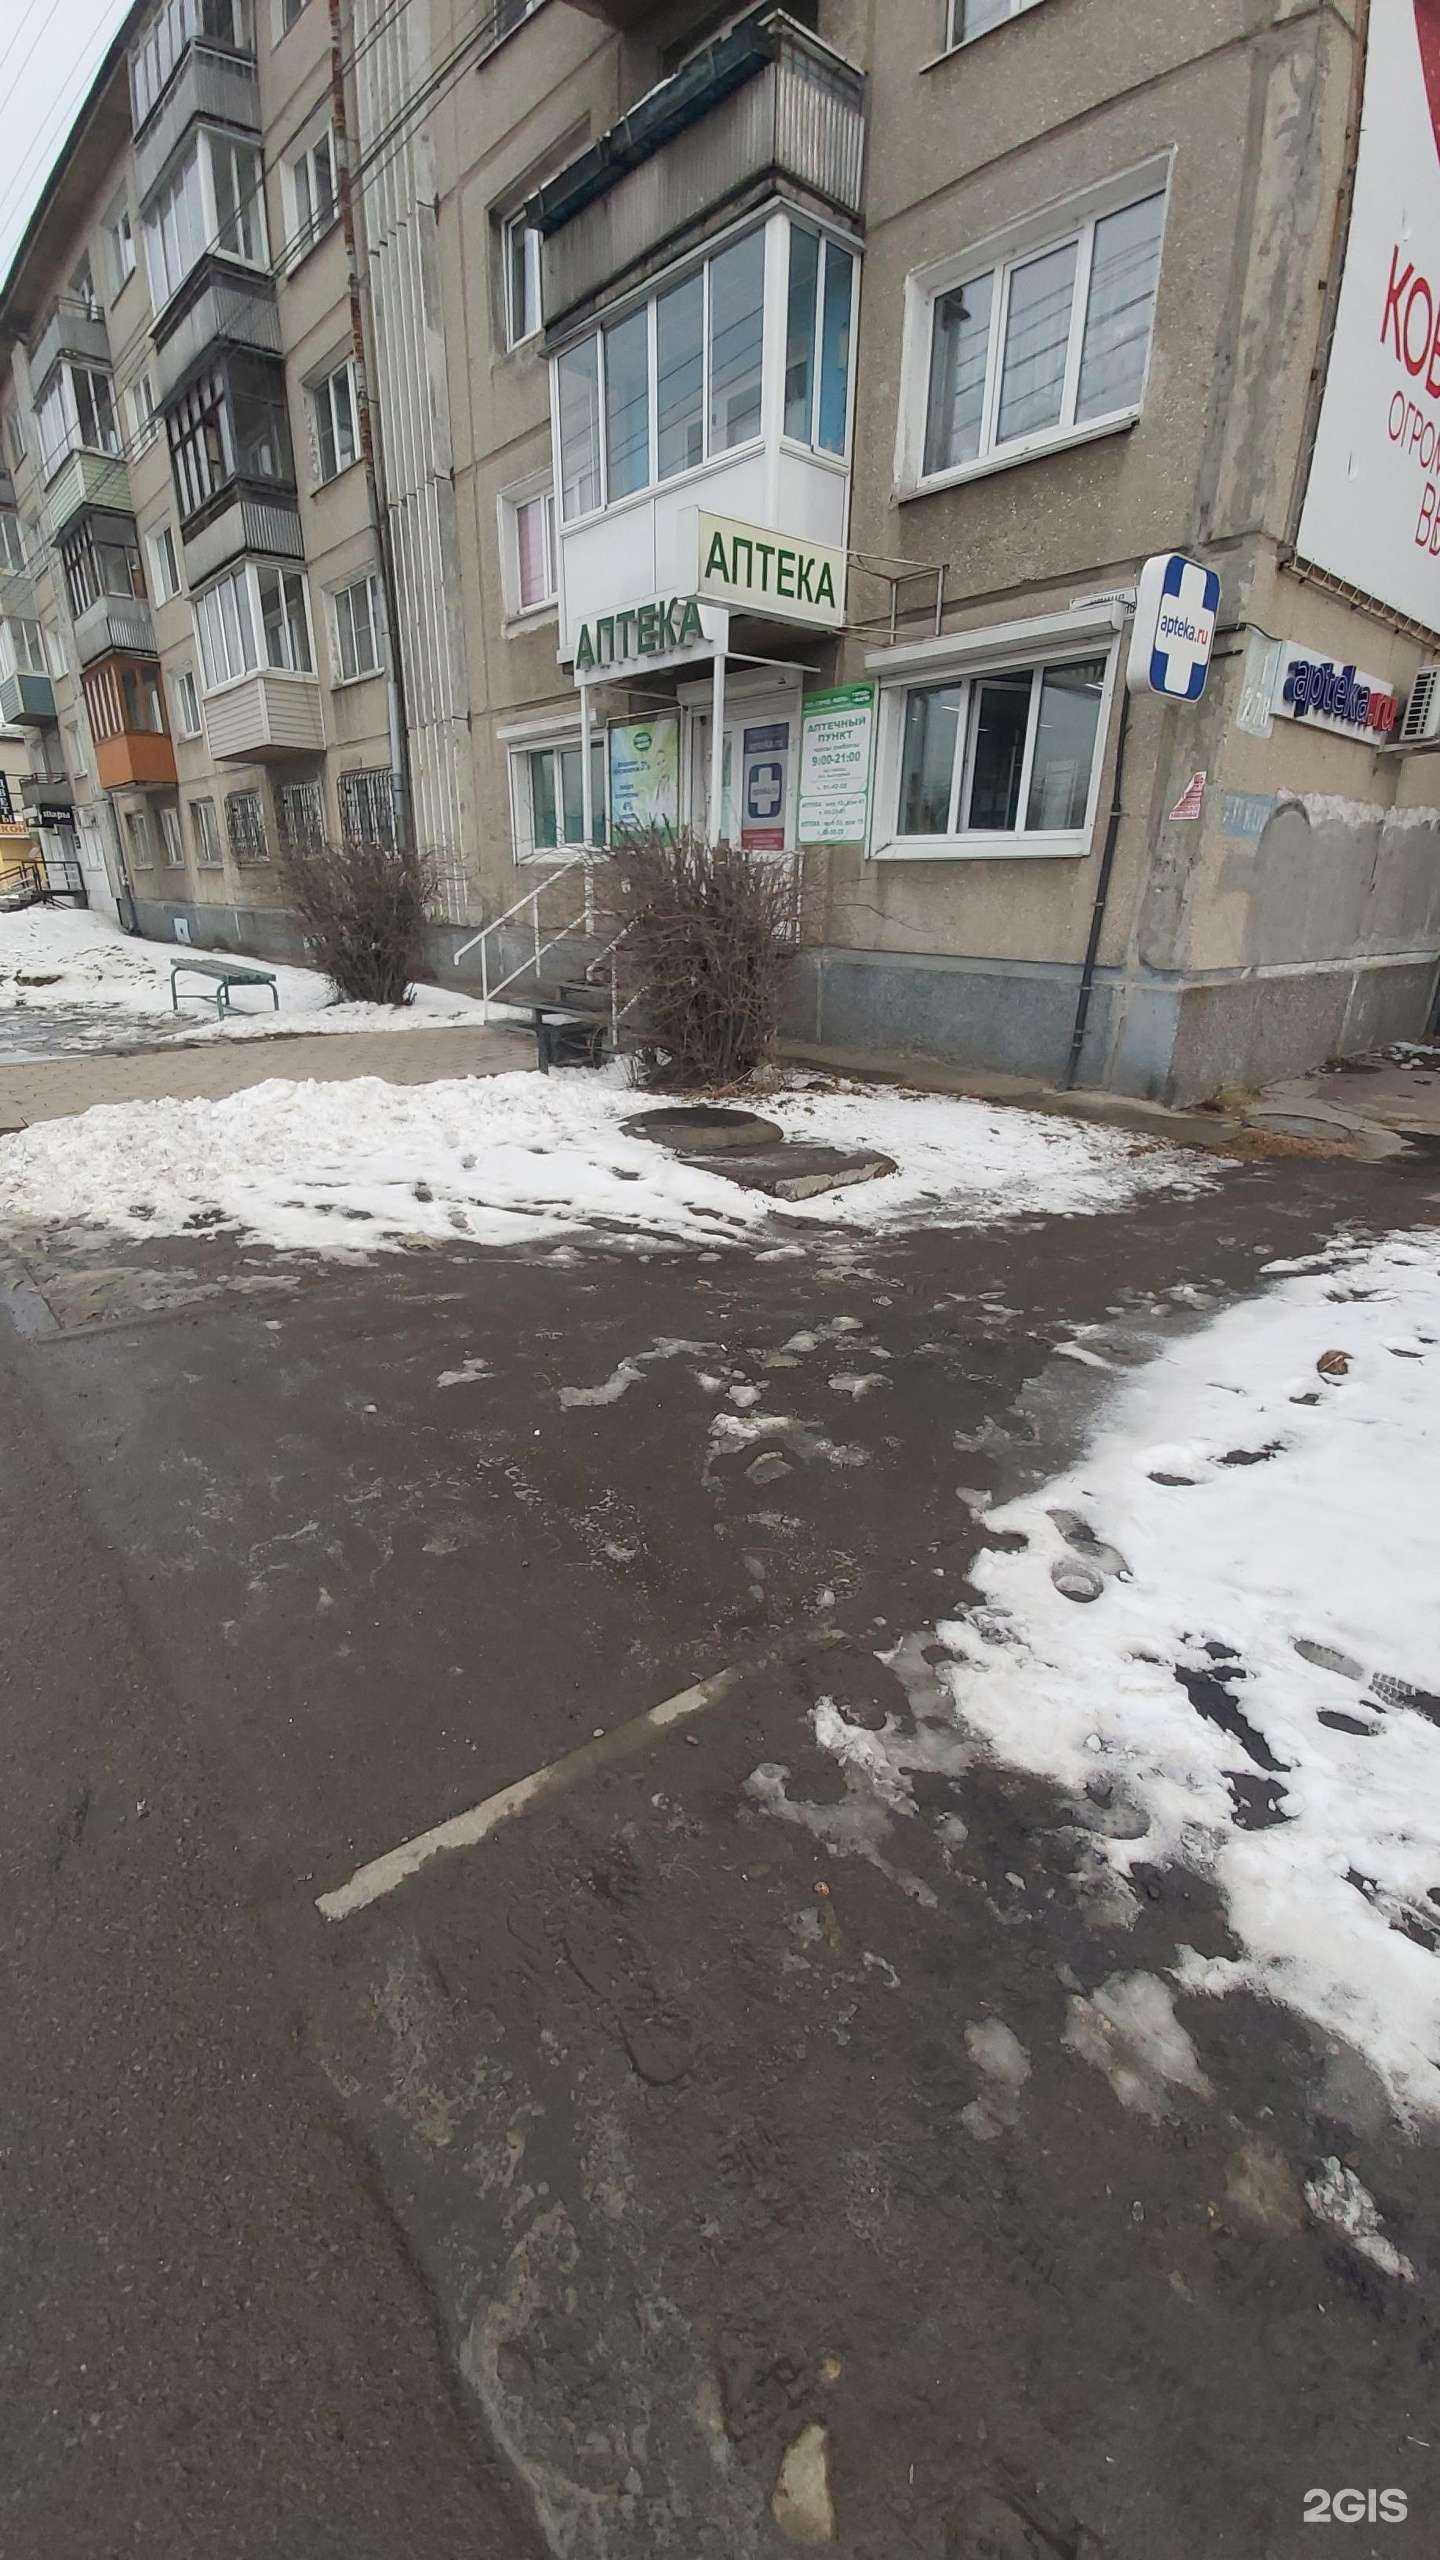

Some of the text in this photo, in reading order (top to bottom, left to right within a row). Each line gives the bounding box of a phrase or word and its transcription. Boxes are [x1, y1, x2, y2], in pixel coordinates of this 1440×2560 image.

[1380, 244, 1440, 399] КО
[1388, 390, 1440, 477] ОГРО
[704, 531, 836, 609] АПТЕКА
[576, 597, 705, 670] АПТЕКА
[1160, 613, 1209, 646] apteka.ru
[808, 716, 867, 733] АПТЕЧНЫЙ
[1285, 660, 1398, 732] apteka.ru
[818, 729, 854, 742] ПУНКТ
